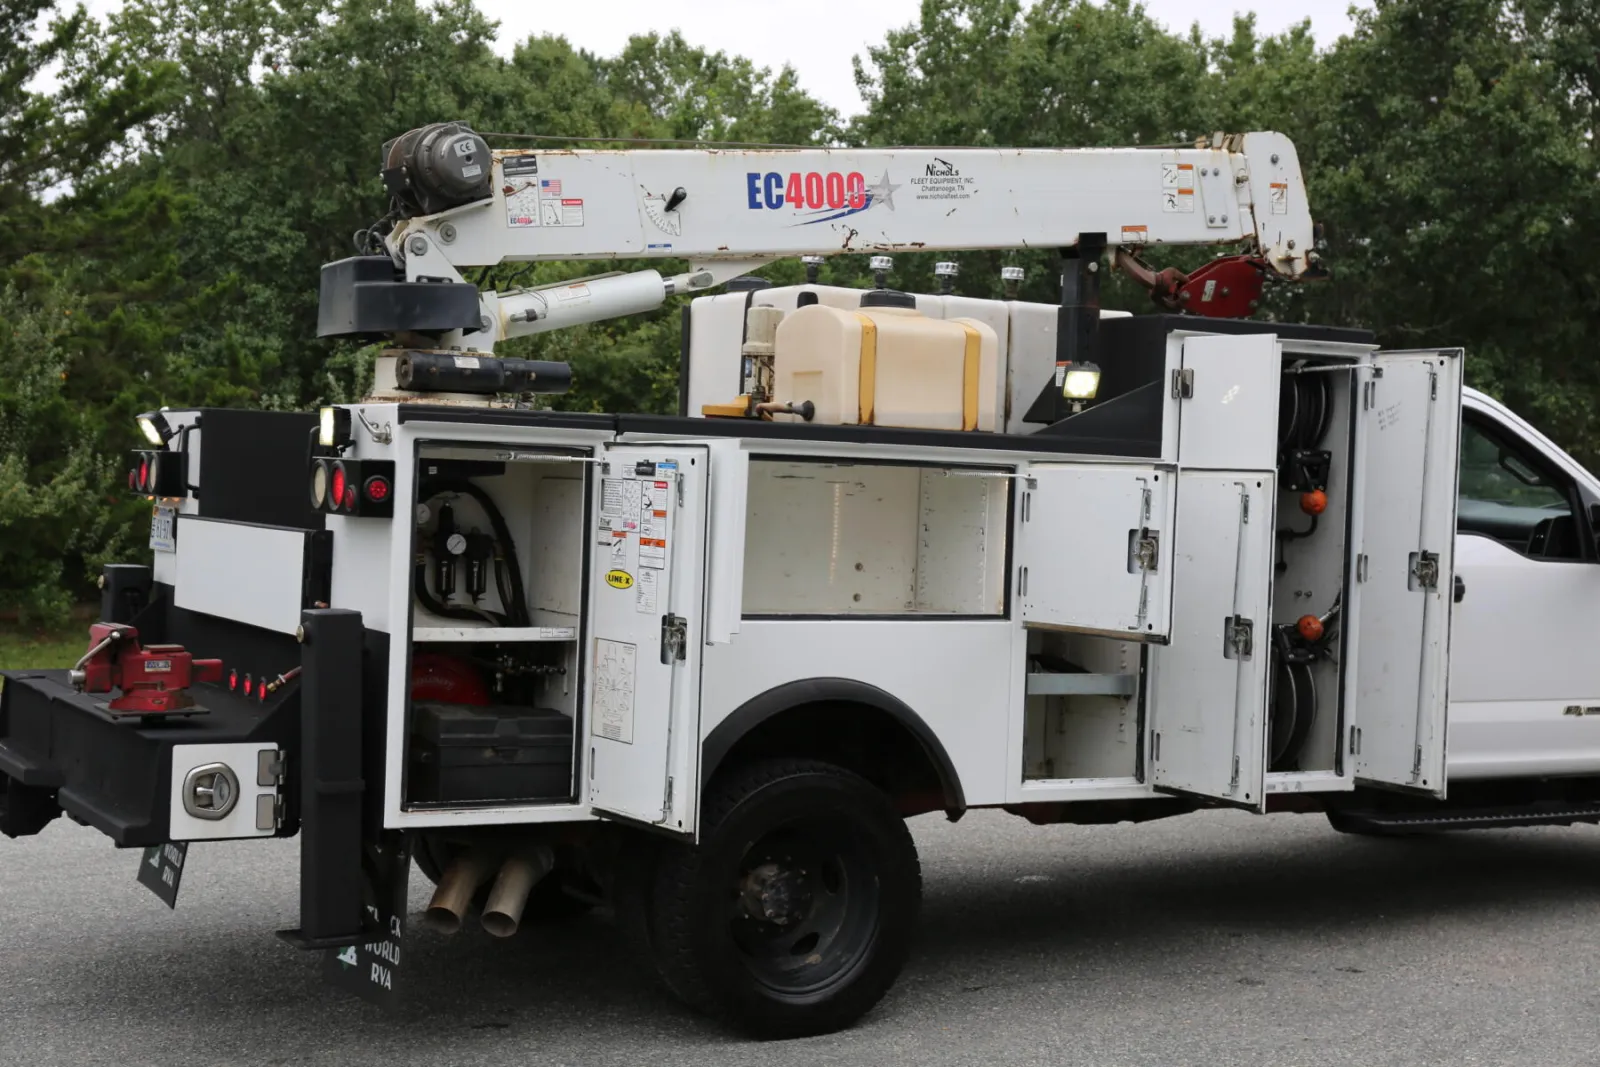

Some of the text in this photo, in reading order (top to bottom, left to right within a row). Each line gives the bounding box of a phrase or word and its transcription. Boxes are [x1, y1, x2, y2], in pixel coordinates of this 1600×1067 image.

[459, 142, 472, 153] CE
[746, 172, 866, 209] EC4000
[911, 177, 928, 185] FLEET
[371, 962, 392, 990] RVA
